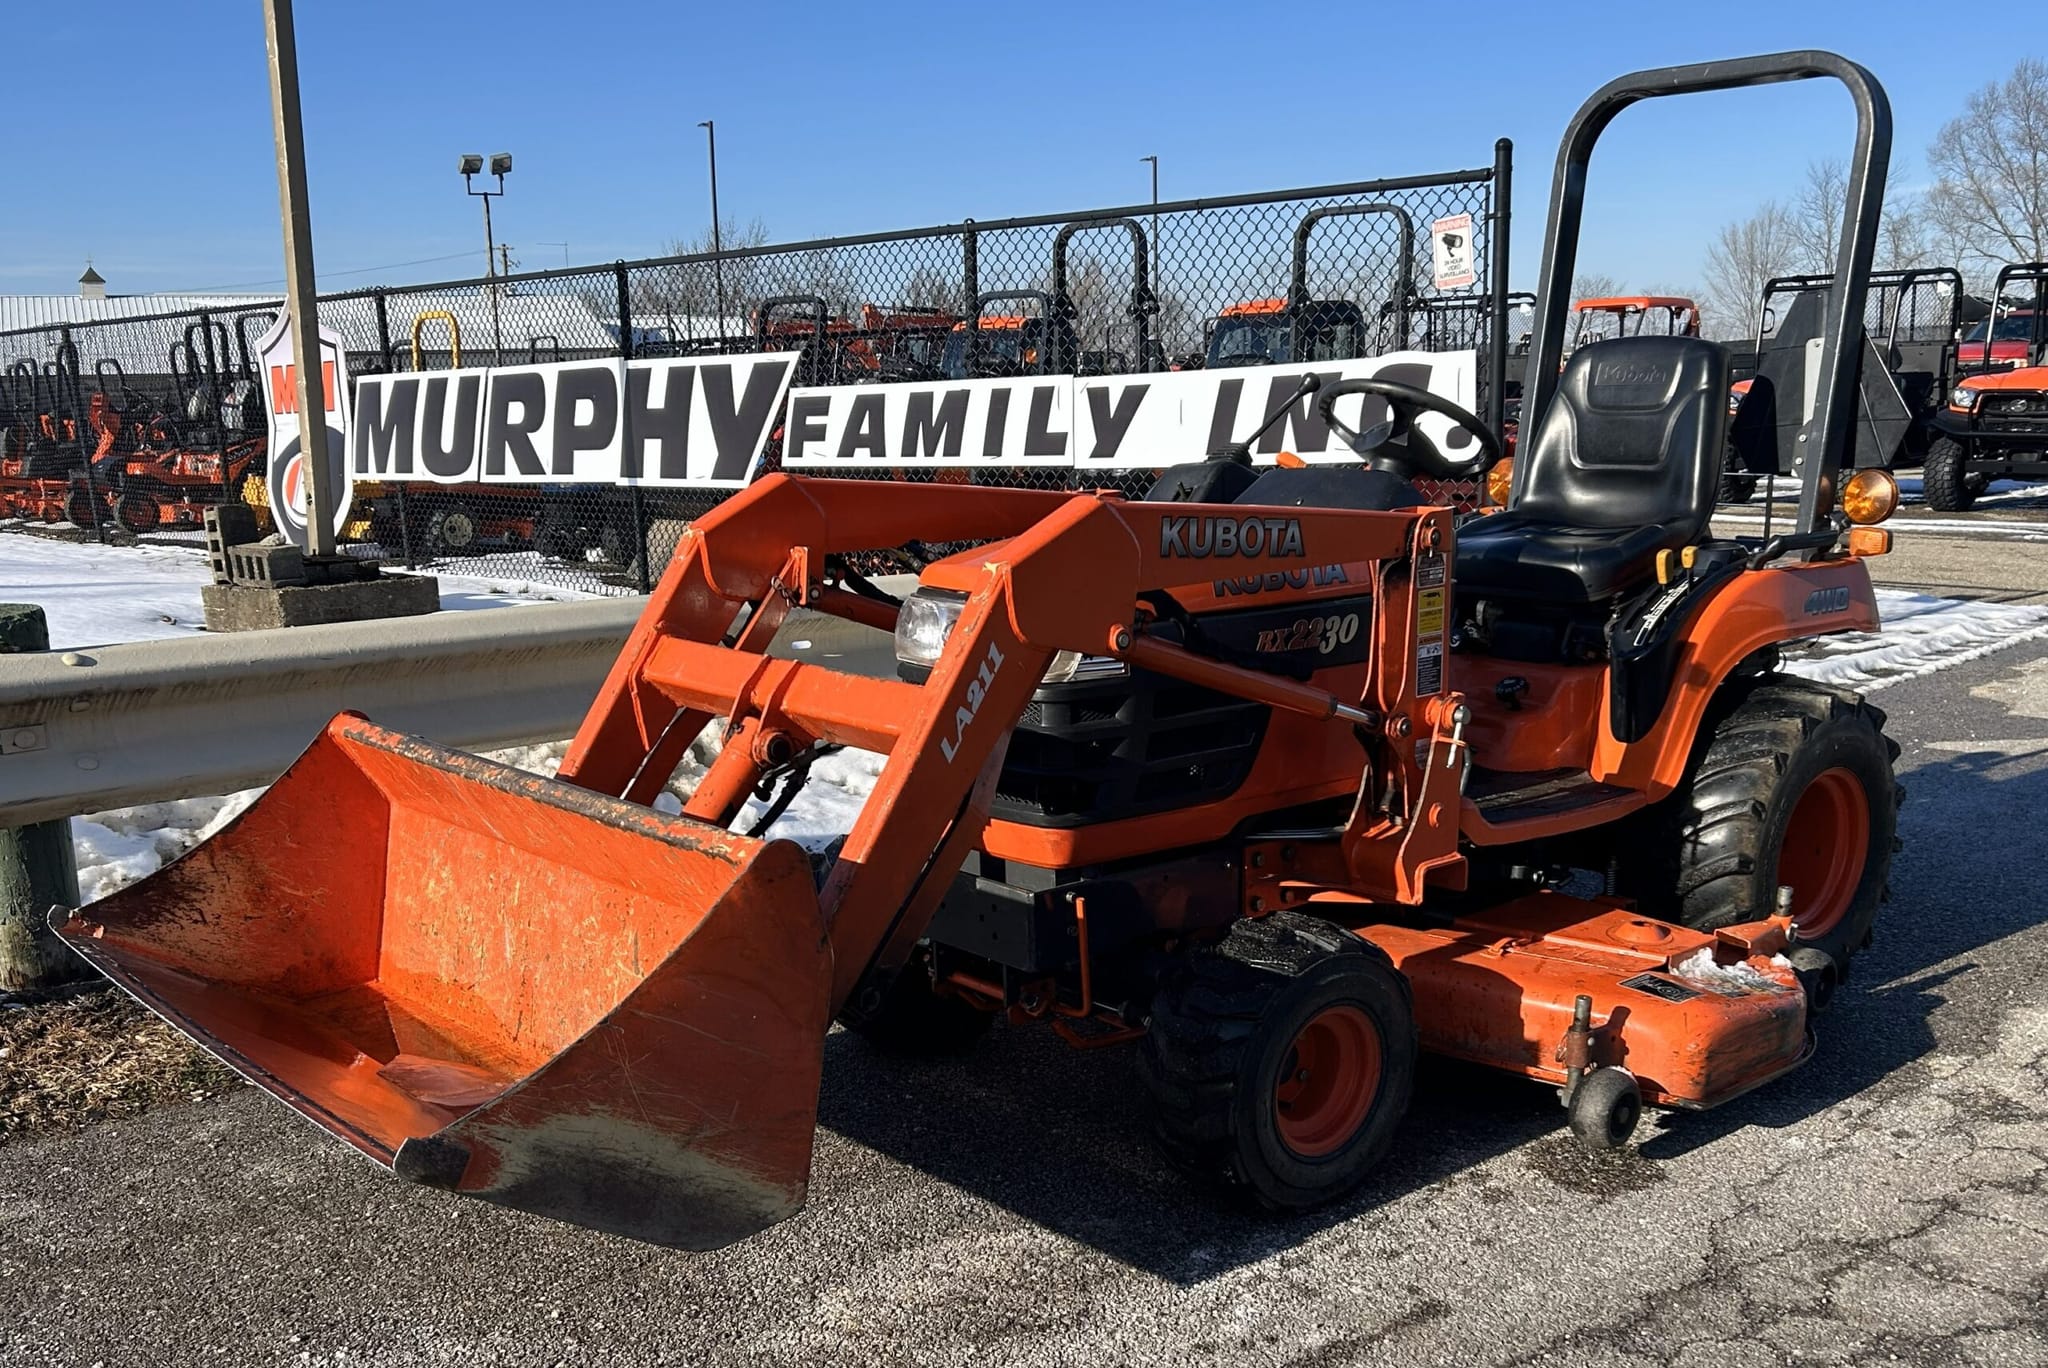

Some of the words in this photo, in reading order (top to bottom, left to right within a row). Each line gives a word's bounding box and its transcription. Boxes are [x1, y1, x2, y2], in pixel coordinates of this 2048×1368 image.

[271, 360, 335, 414] MI
[355, 360, 790, 480] MURPHY
[787, 383, 1151, 458] FAMILY
[1160, 516, 1306, 558] KUBOTA
[1804, 586, 1849, 615] 4WD
[940, 641, 1005, 765] LA211
